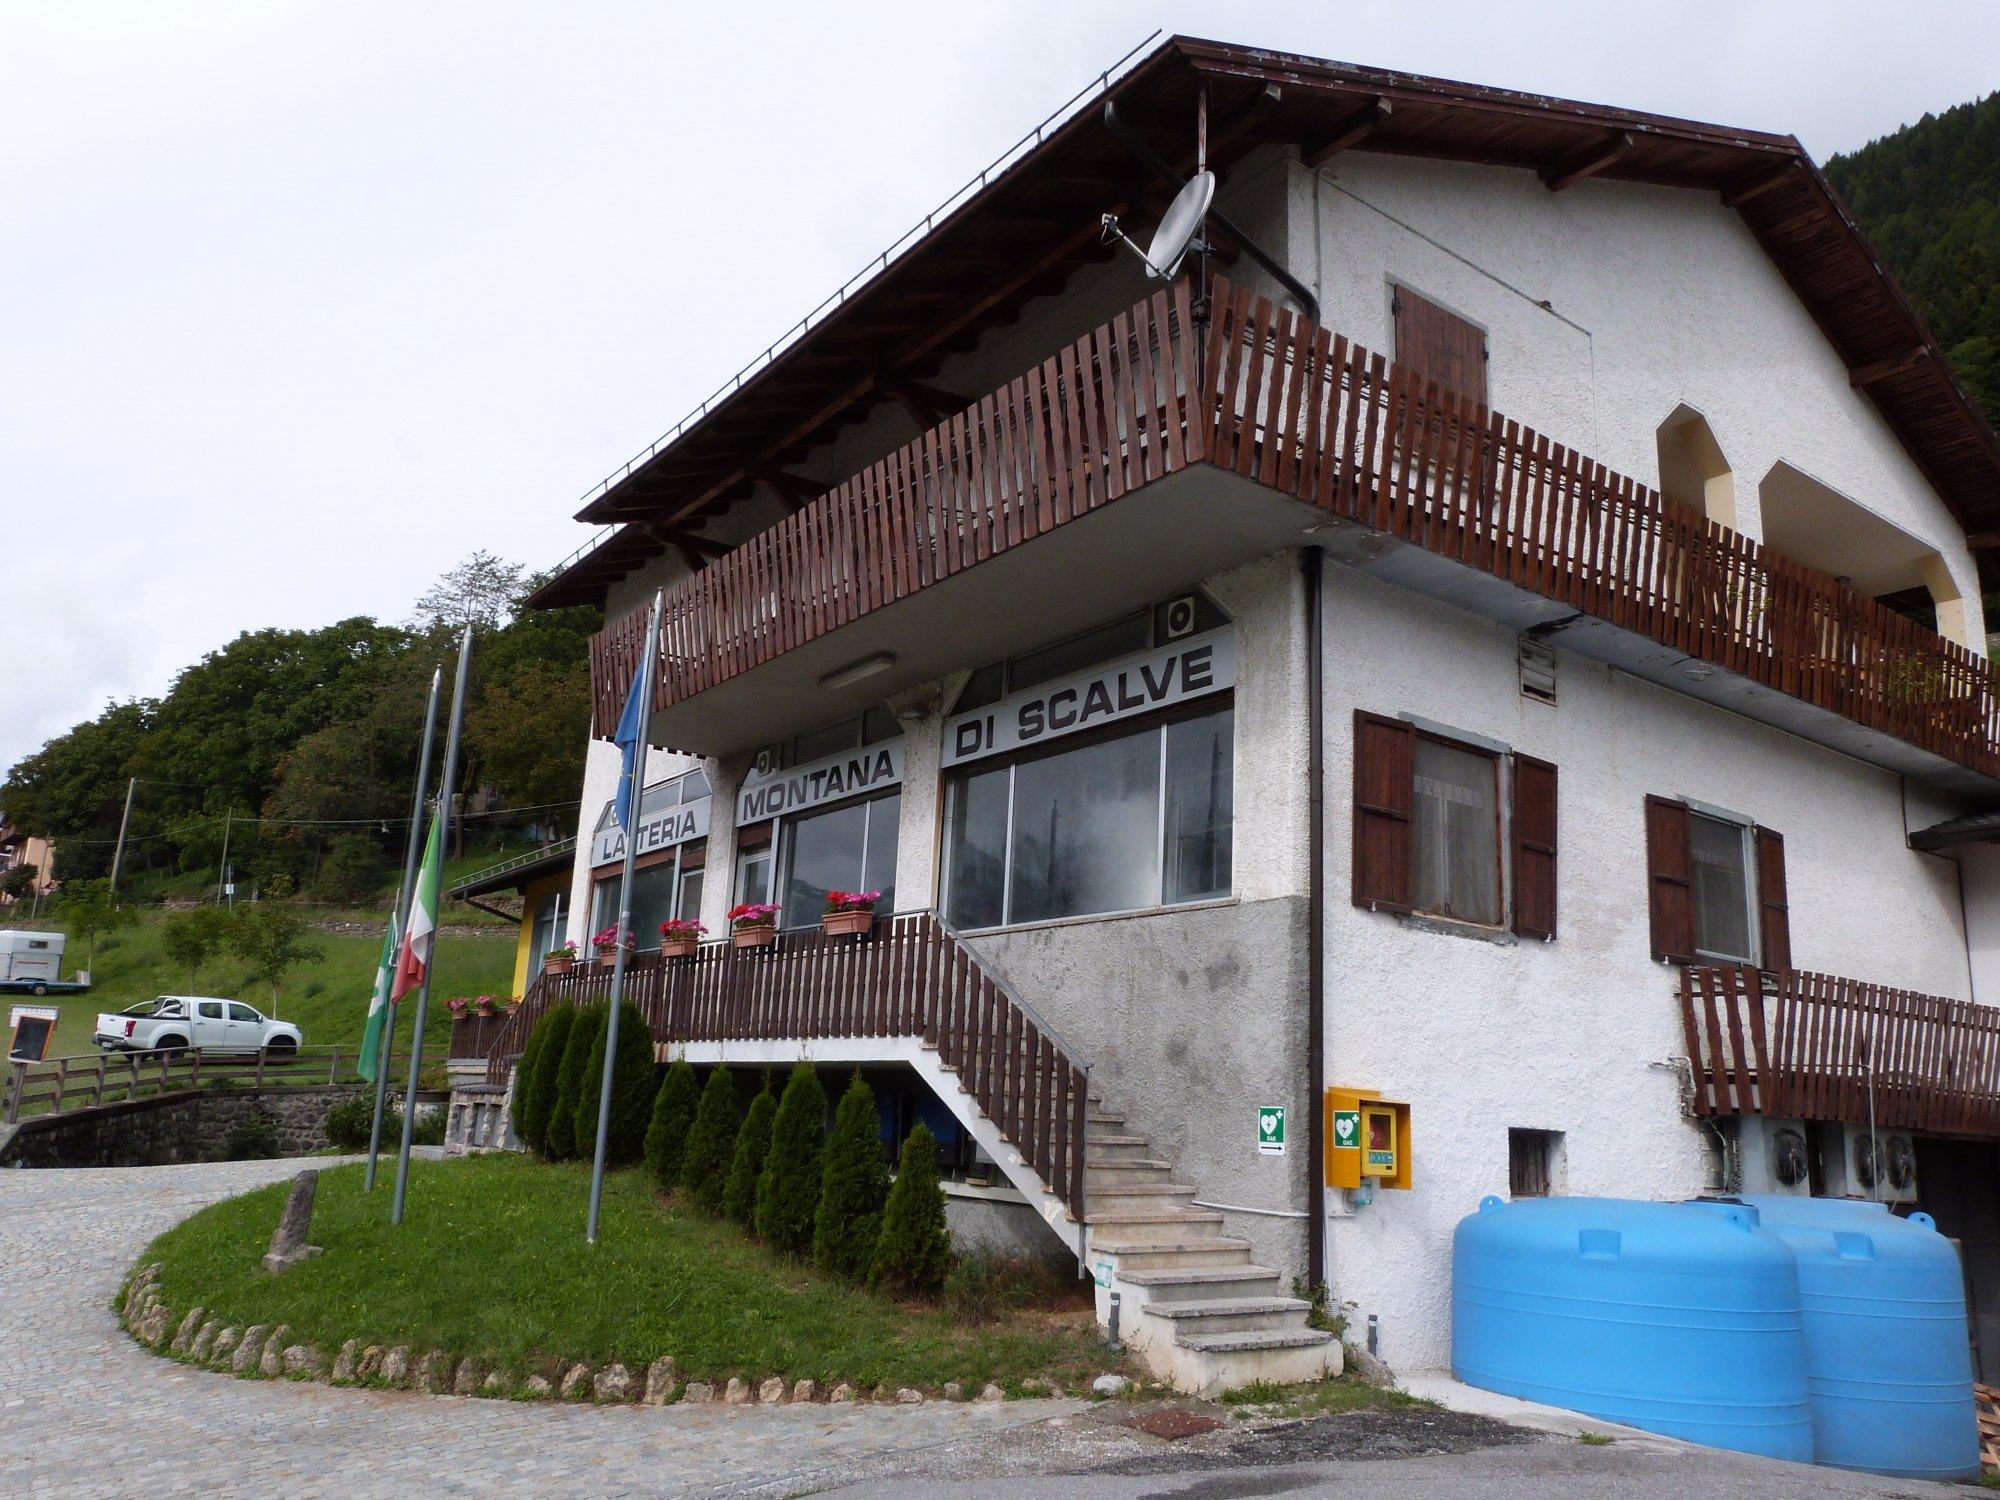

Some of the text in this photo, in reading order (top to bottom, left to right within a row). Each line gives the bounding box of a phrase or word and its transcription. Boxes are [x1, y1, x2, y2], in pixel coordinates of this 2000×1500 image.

[956, 645, 1213, 758] DI SCALVE
[743, 750, 895, 821] MONTANA
[603, 810, 696, 860] LATERIA
